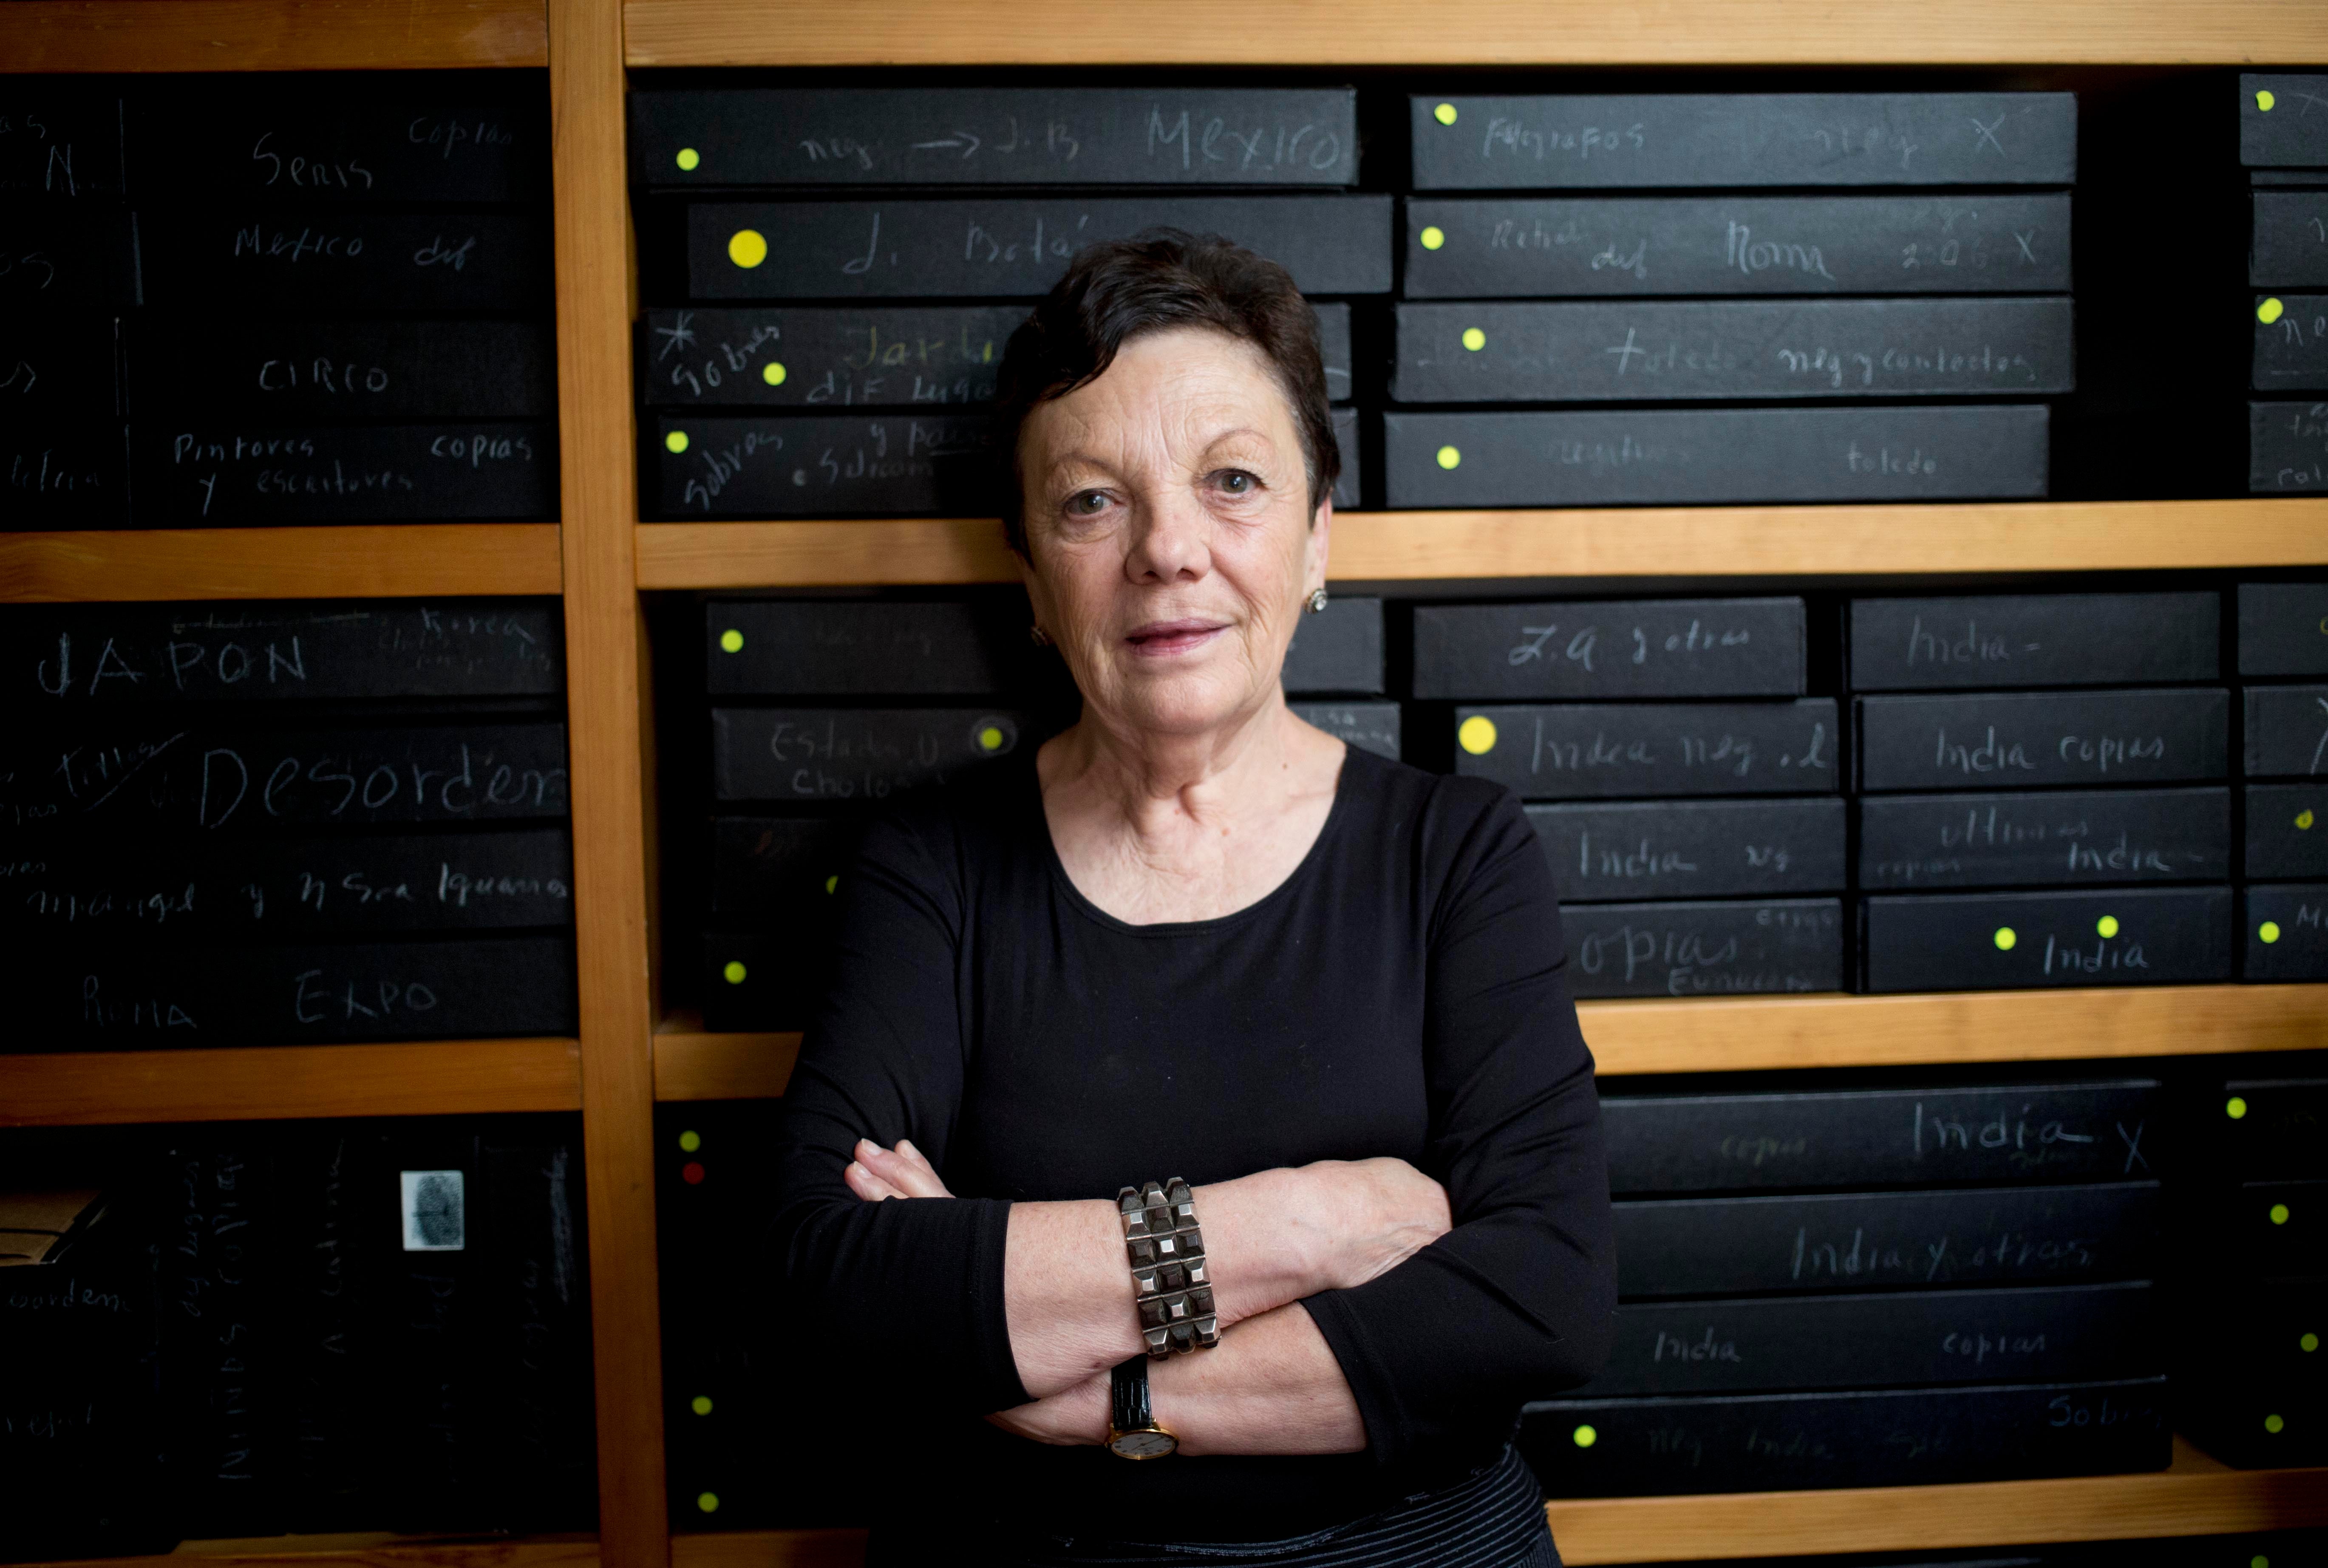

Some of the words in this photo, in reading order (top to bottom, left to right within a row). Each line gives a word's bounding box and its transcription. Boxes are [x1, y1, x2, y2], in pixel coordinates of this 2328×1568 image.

[258, 356, 388, 394] CIRCO
[37, 631, 307, 699] JAPON
[2044, 934, 2150, 975] India
[1653, 1325, 1743, 1364] India
